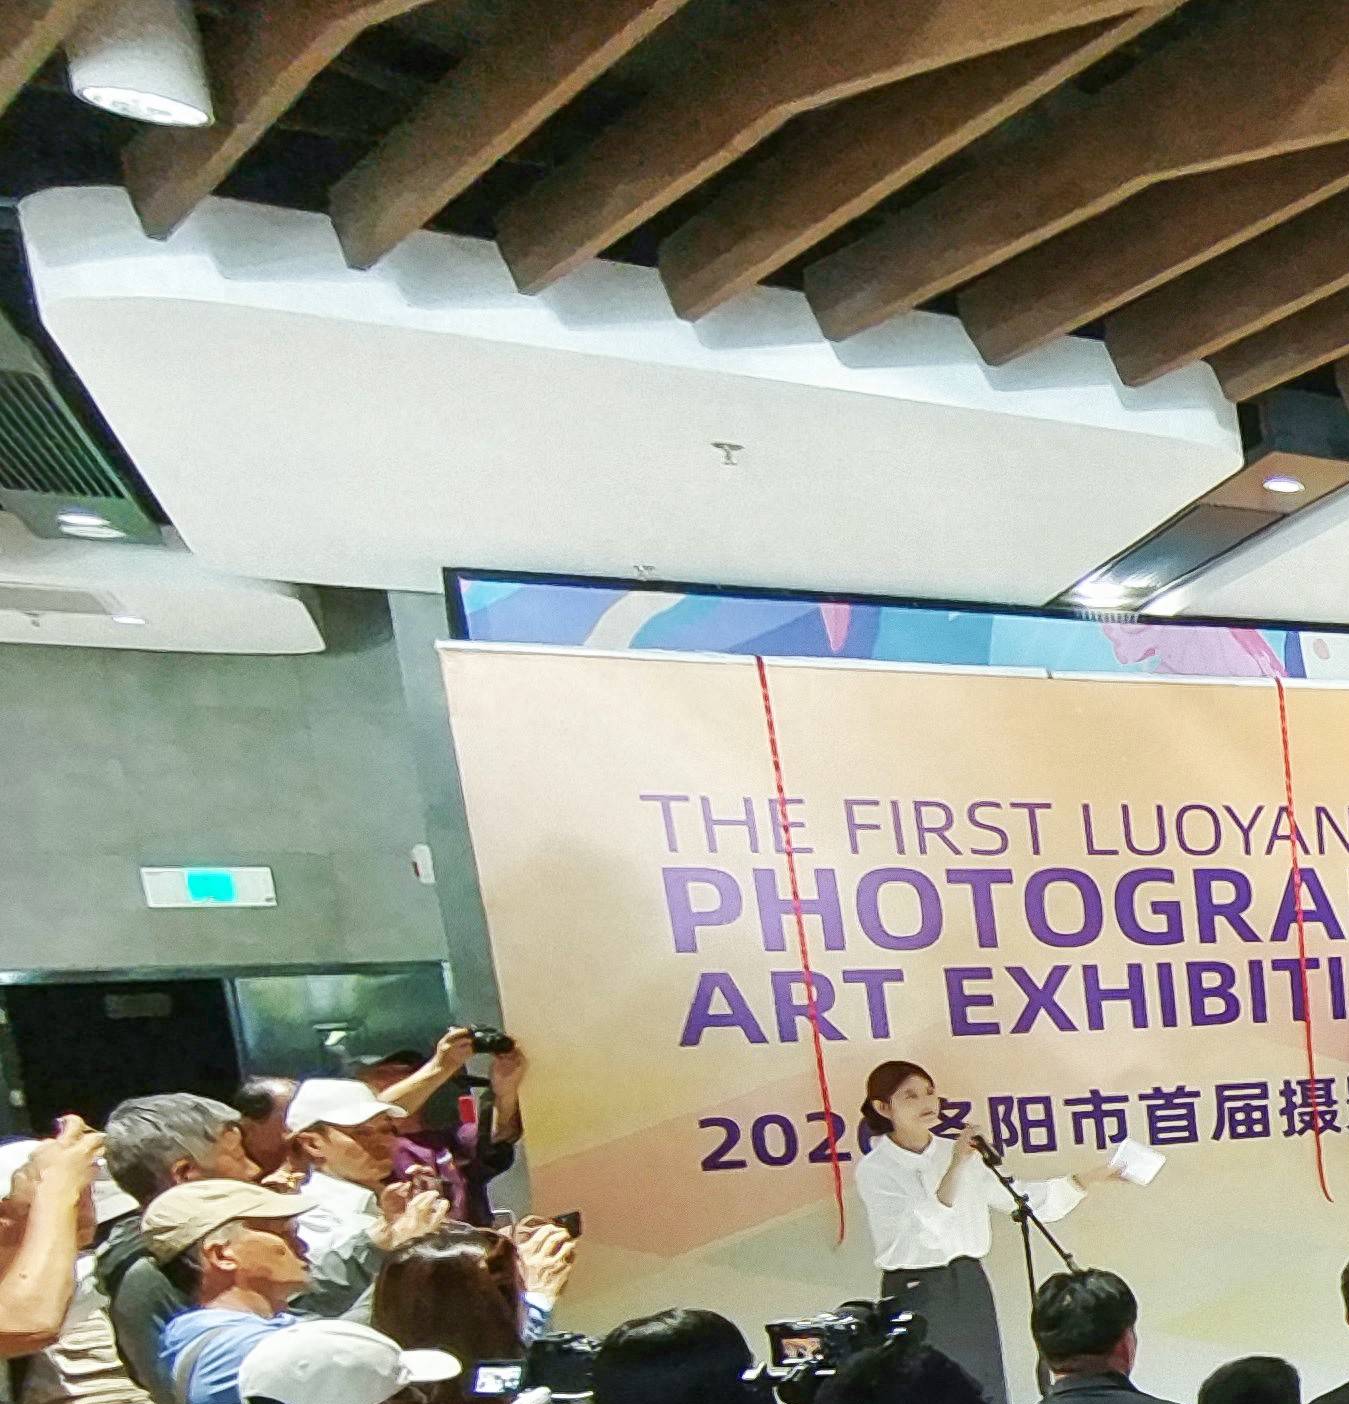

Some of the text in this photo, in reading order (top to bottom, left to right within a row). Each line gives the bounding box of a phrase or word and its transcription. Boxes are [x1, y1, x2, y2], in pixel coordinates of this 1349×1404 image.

[638, 793, 807, 858] THE
[848, 799, 1065, 857] FIRST
[677, 965, 905, 1049] ART
